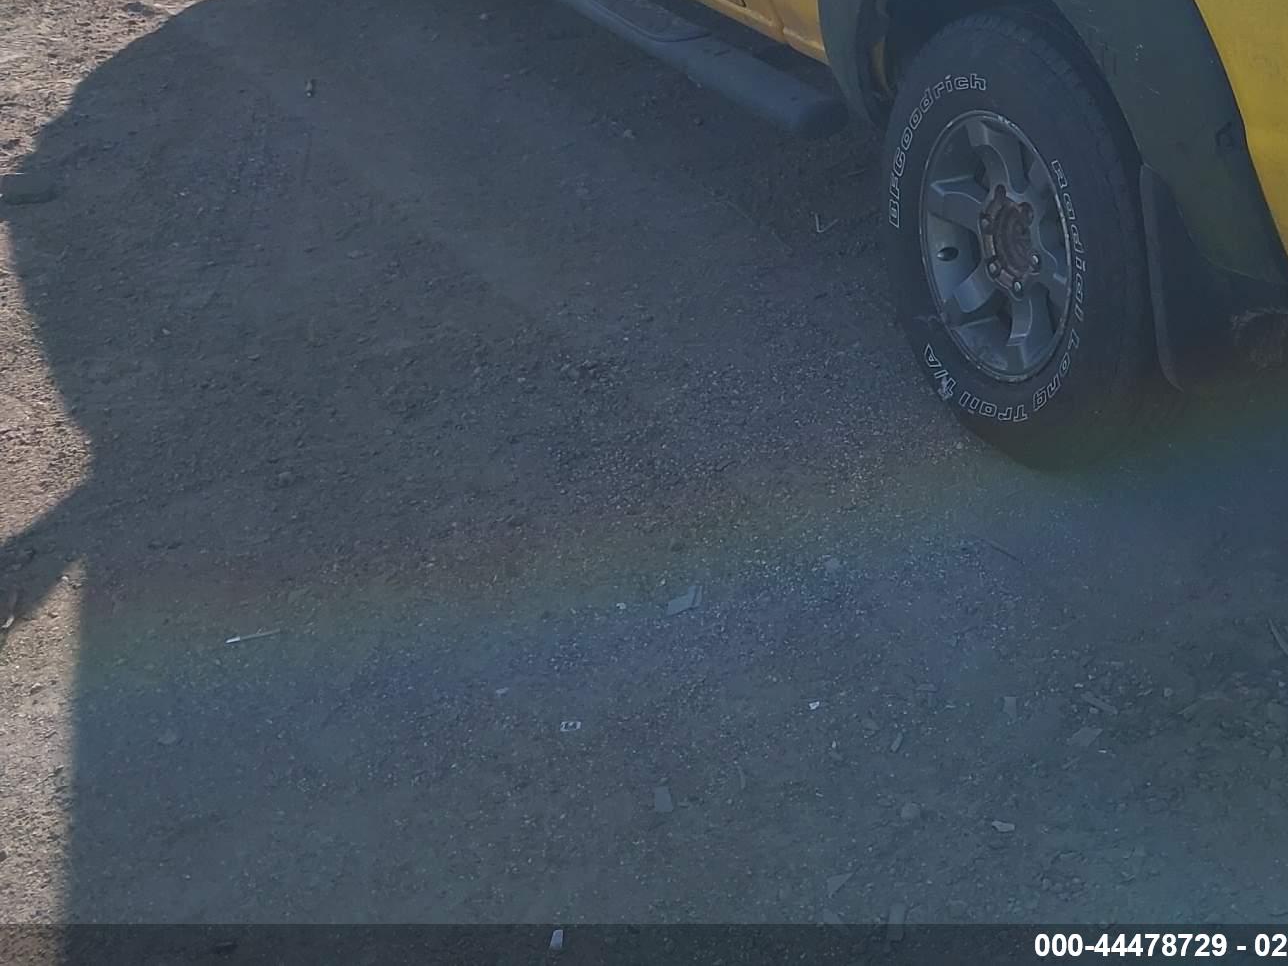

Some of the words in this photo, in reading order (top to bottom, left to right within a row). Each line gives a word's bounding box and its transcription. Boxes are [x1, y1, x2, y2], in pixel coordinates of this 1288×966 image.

[889, 72, 987, 229] BFGoodrich
[1050, 159, 1087, 323] Radial
[923, 343, 957, 399] T/A
[958, 391, 1029, 423] Trail
[1033, 328, 1081, 412] Long
